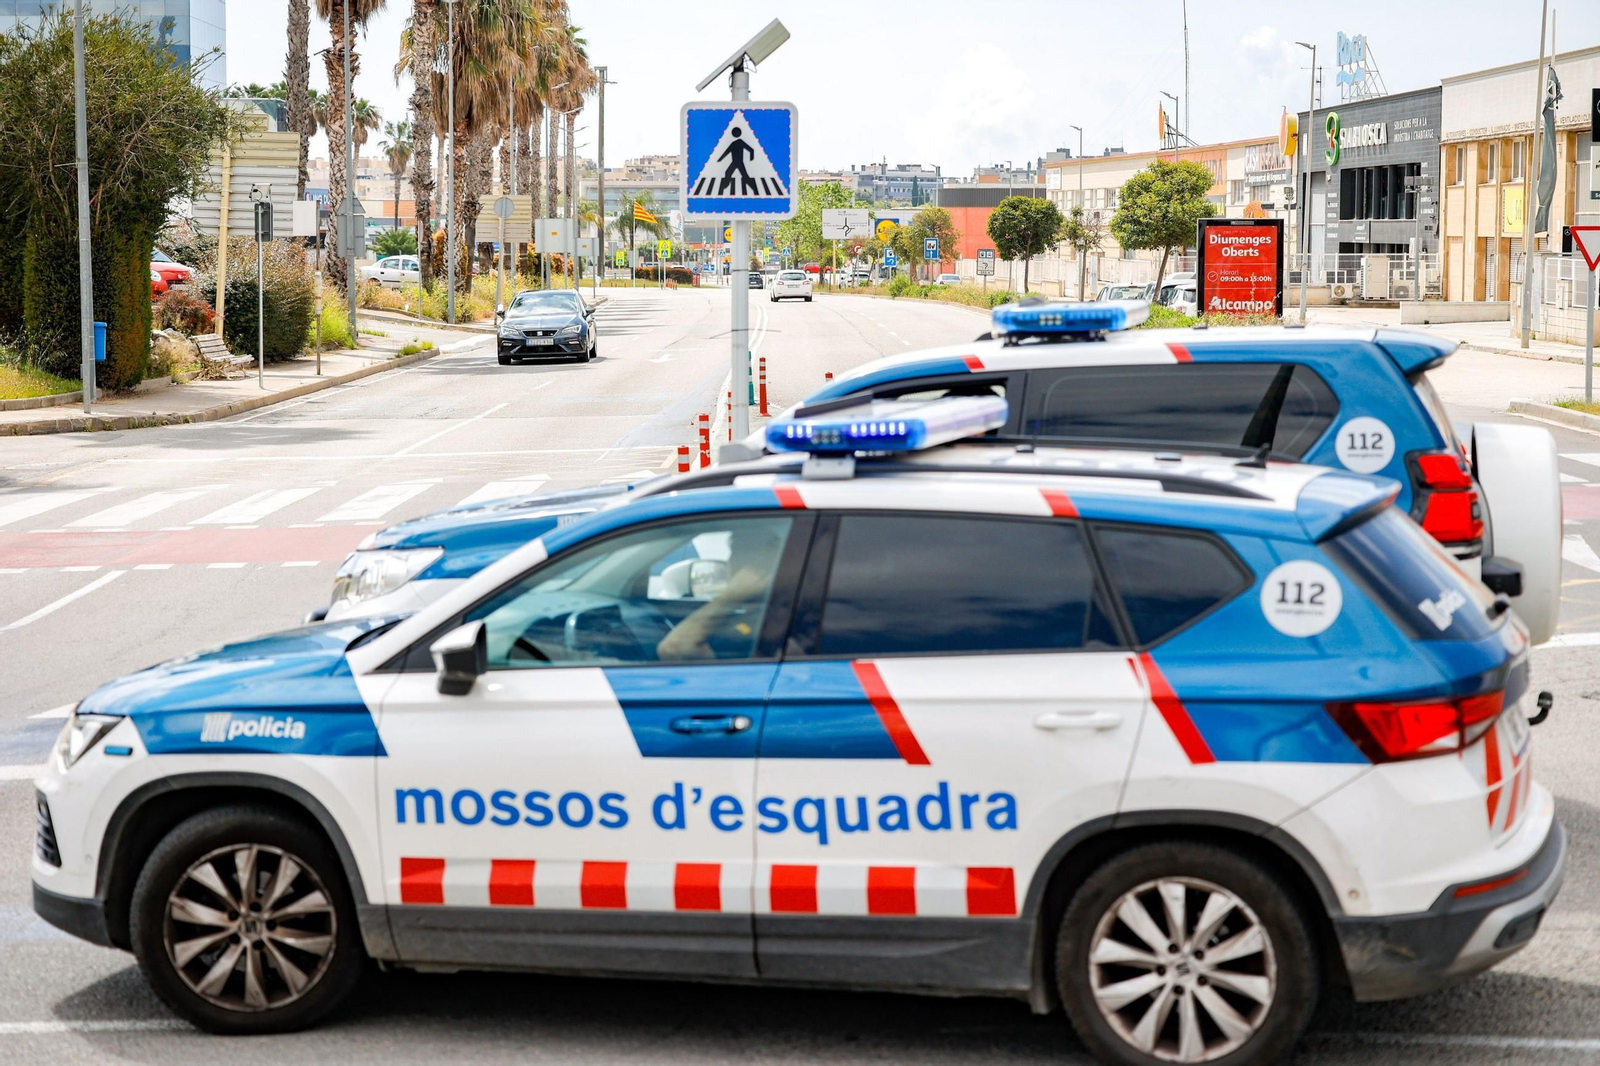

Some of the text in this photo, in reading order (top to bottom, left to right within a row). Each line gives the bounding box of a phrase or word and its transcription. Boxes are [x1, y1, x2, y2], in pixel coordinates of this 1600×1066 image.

[1337, 31, 1364, 67] Roca
[1209, 234, 1272, 247] Diumenges
[1221, 247, 1260, 257] Oberts
[1208, 296, 1273, 312] Alcampo
[1348, 433, 1383, 450] 112
[1277, 581, 1325, 605] 112
[227, 716, 306, 741] policia
[395, 781, 1020, 845] mossos d'esquadra
